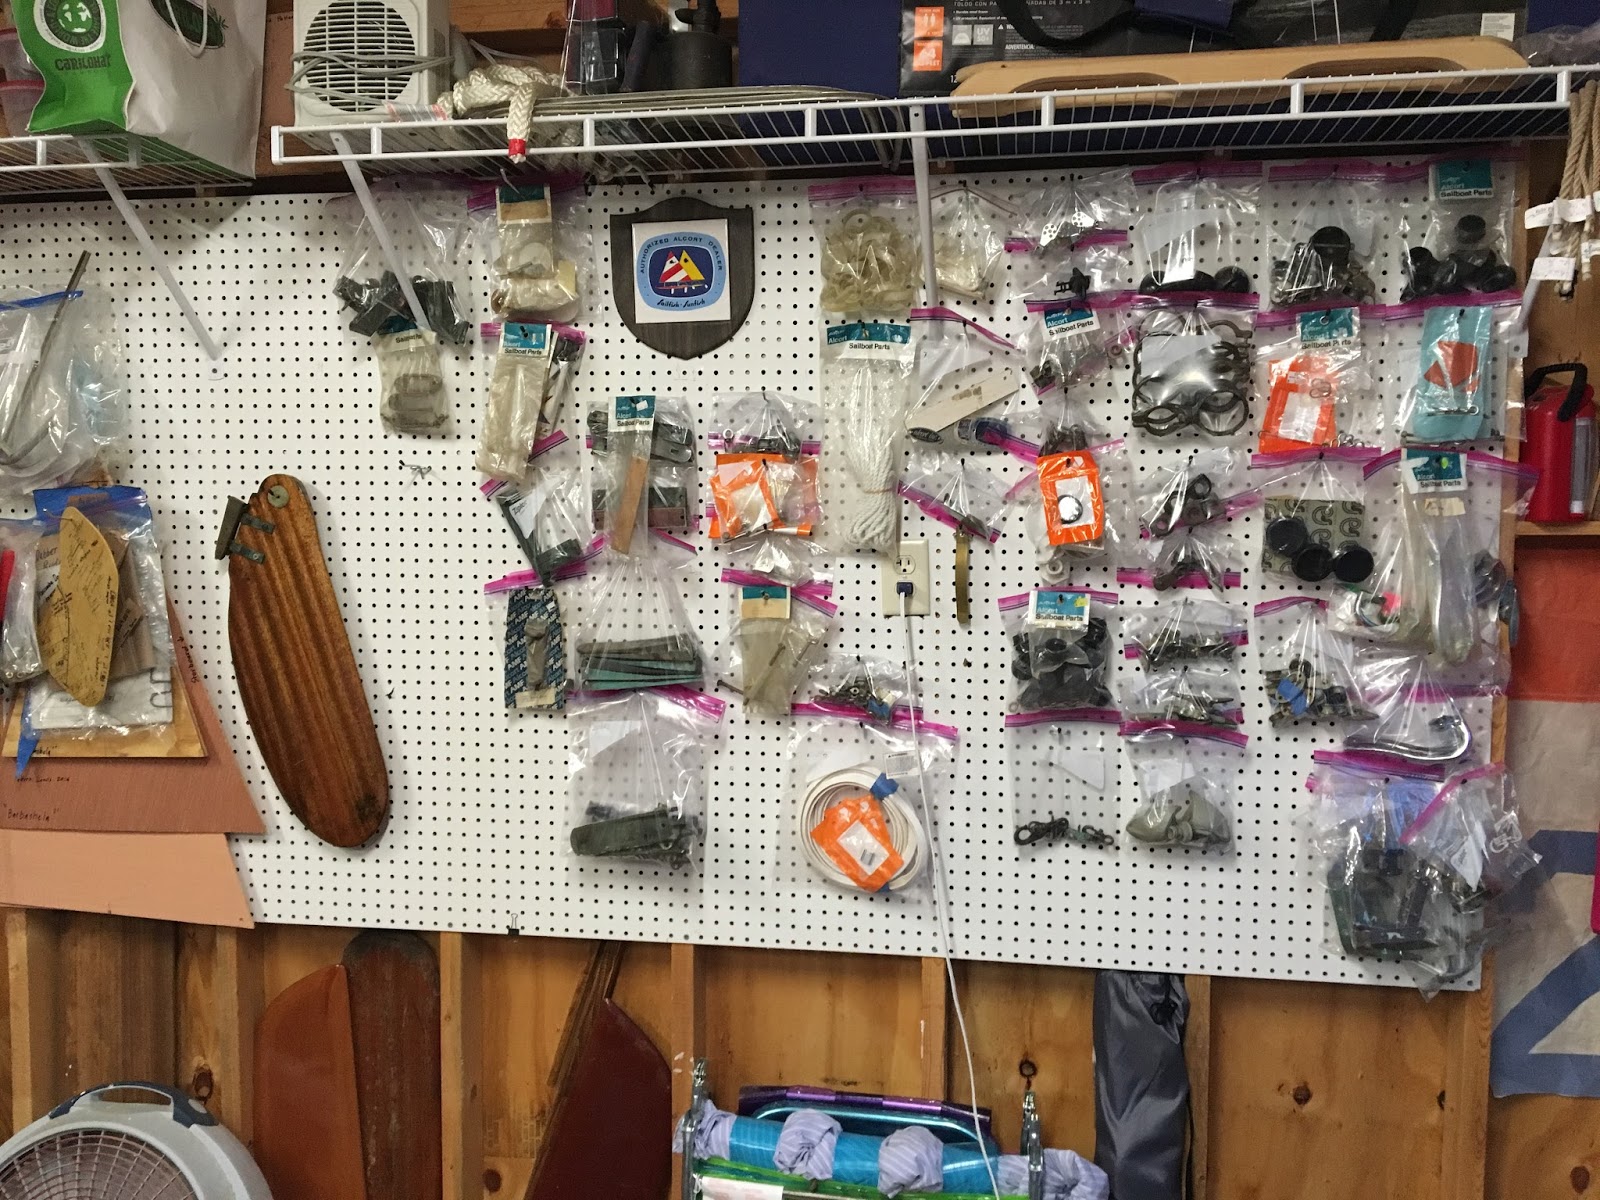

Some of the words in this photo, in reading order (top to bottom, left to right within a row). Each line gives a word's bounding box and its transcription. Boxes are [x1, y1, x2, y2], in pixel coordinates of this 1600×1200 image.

[976, 27, 990, 36] UV
[1441, 189, 1472, 198] Sailboat
[640, 238, 669, 273] AUTHORIZED
[708, 241, 723, 271] DEALER
[1047, 317, 1068, 327] Alcort
[1049, 323, 1077, 335] Sailboat
[1077, 320, 1094, 329] Parts
[828, 335, 848, 344] Alcort
[849, 342, 873, 350] Sailboat
[1302, 341, 1331, 350] Sailboat
[504, 347, 528, 355] Sailboat
[1035, 613, 1065, 621] Sailboat
